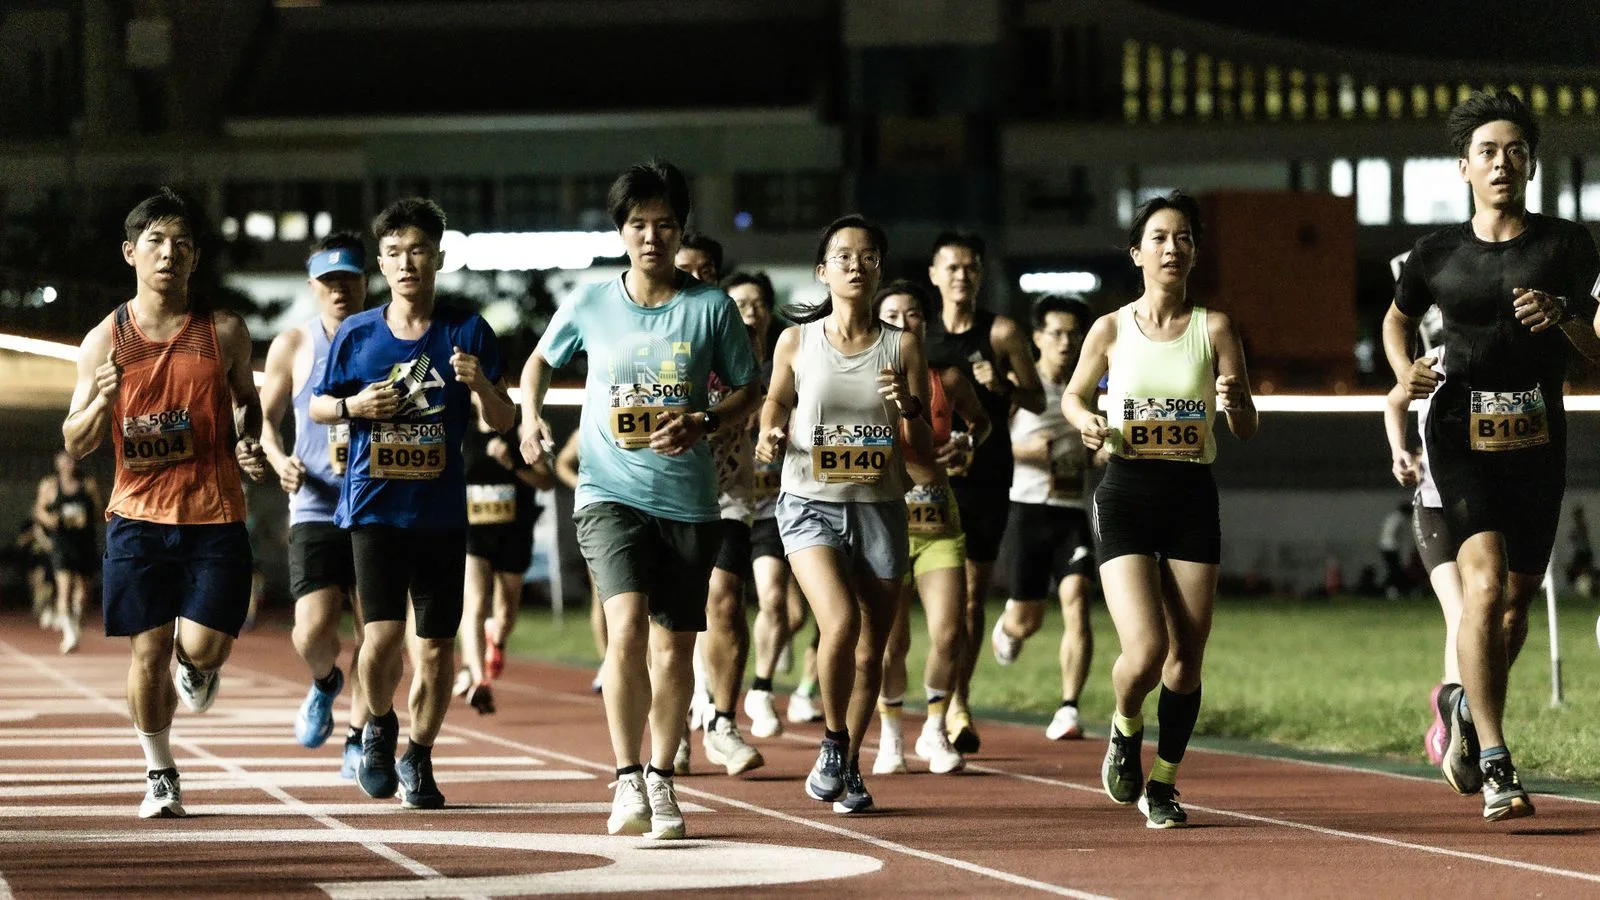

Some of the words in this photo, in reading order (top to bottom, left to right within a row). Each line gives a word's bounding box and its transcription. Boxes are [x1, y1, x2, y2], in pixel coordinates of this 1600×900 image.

[1123, 398, 1135, 420] 高雄
[1165, 398, 1206, 412] 5000
[149, 409, 189, 426] 5000
[410, 424, 446, 437] 5000
[813, 425, 824, 445] 高雄
[853, 425, 892, 438] 5000
[1131, 425, 1199, 445] B136
[123, 437, 186, 459] B004
[377, 448, 440, 467] B095
[821, 450, 886, 469] B140
